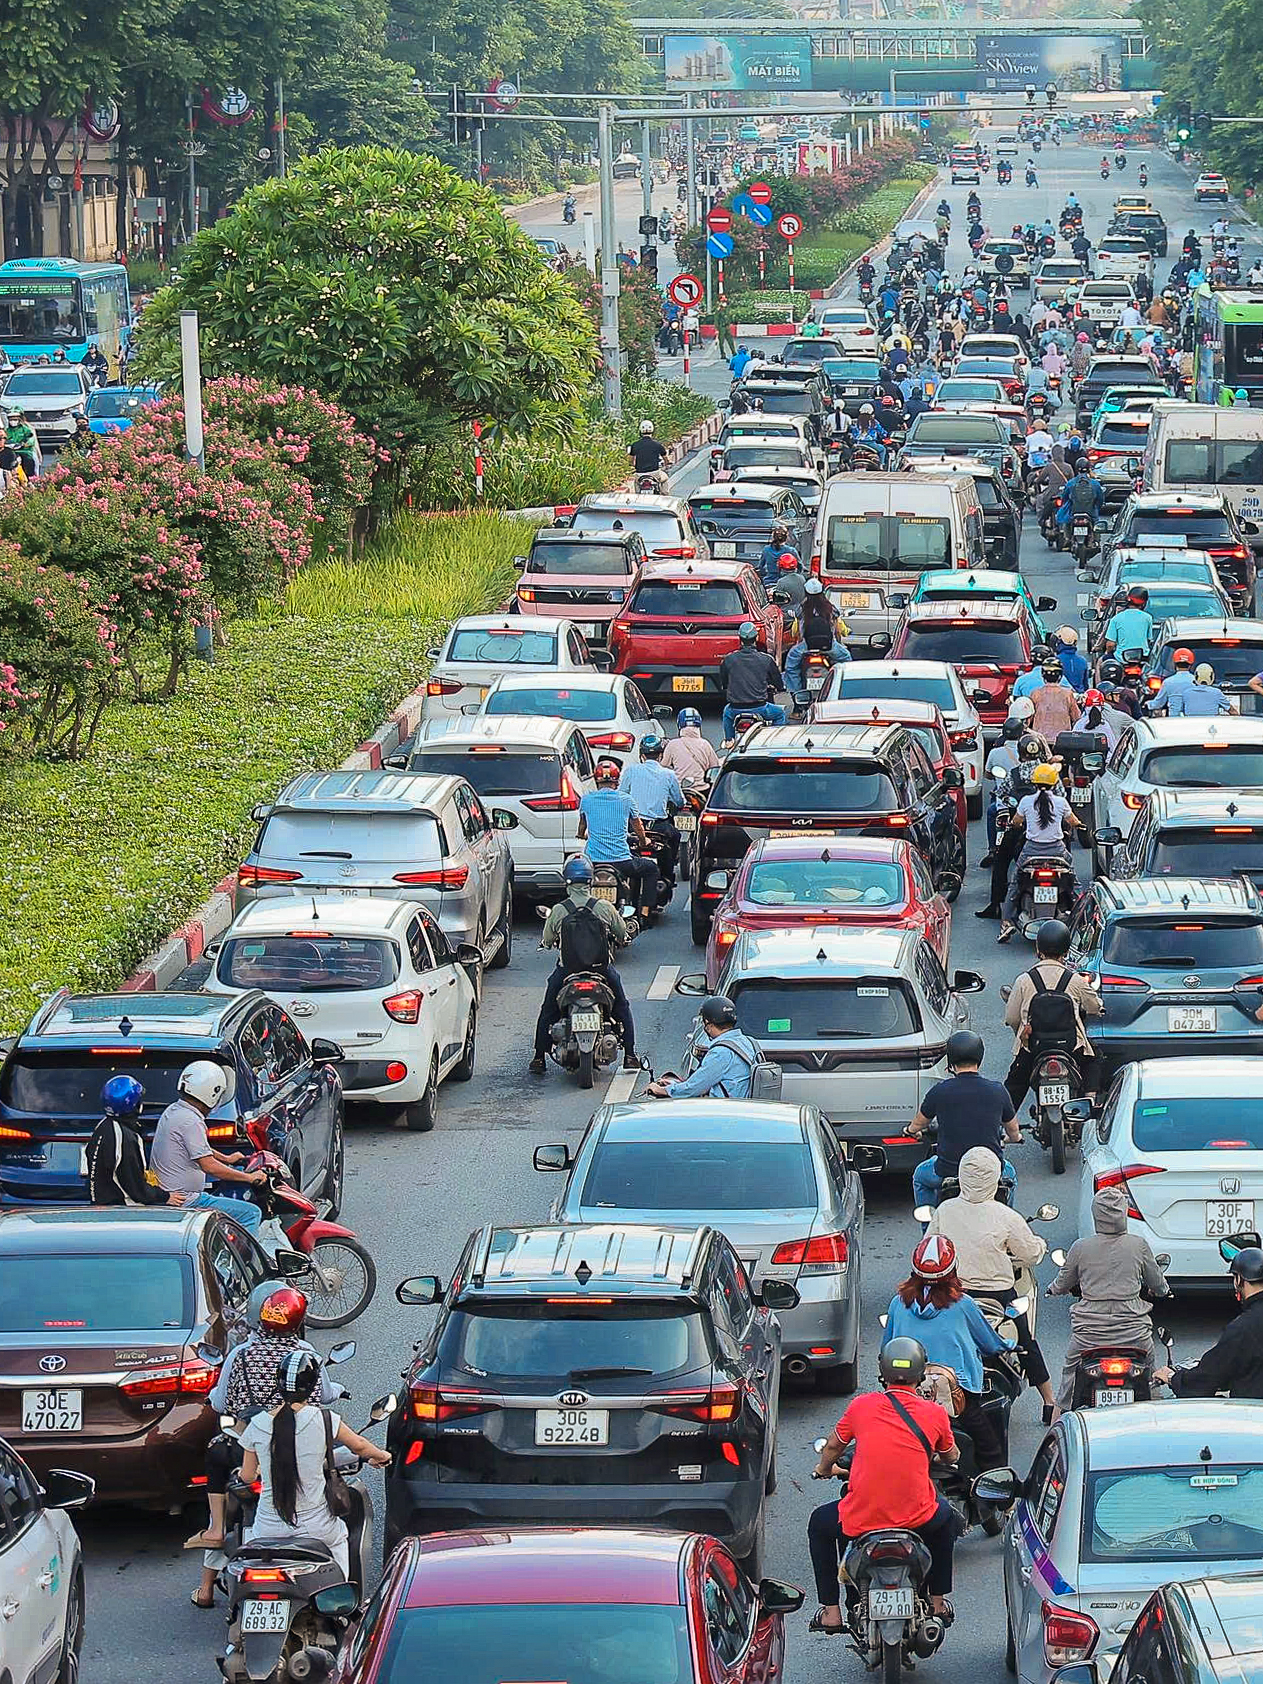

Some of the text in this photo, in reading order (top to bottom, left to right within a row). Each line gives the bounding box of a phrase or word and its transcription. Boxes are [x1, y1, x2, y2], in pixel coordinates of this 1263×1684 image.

[748, 64, 771, 78] MẶT
[774, 61, 800, 76] BIỂN
[1218, 1203, 1243, 1218] 30F
[1208, 1219, 1254, 1234] 291.79
[36, 1392, 70, 1411] 30E
[563, 1394, 584, 1404] KIA
[1101, 1391, 1128, 1403] 89-F1
[24, 1411, 82, 1430] 470.27
[558, 1411, 589, 1426] 30G
[543, 1427, 601, 1443] 922.48
[875, 1591, 907, 1604] 29-T1
[249, 1602, 283, 1616] 29-AC
[244, 1616, 286, 1630] 689.32
